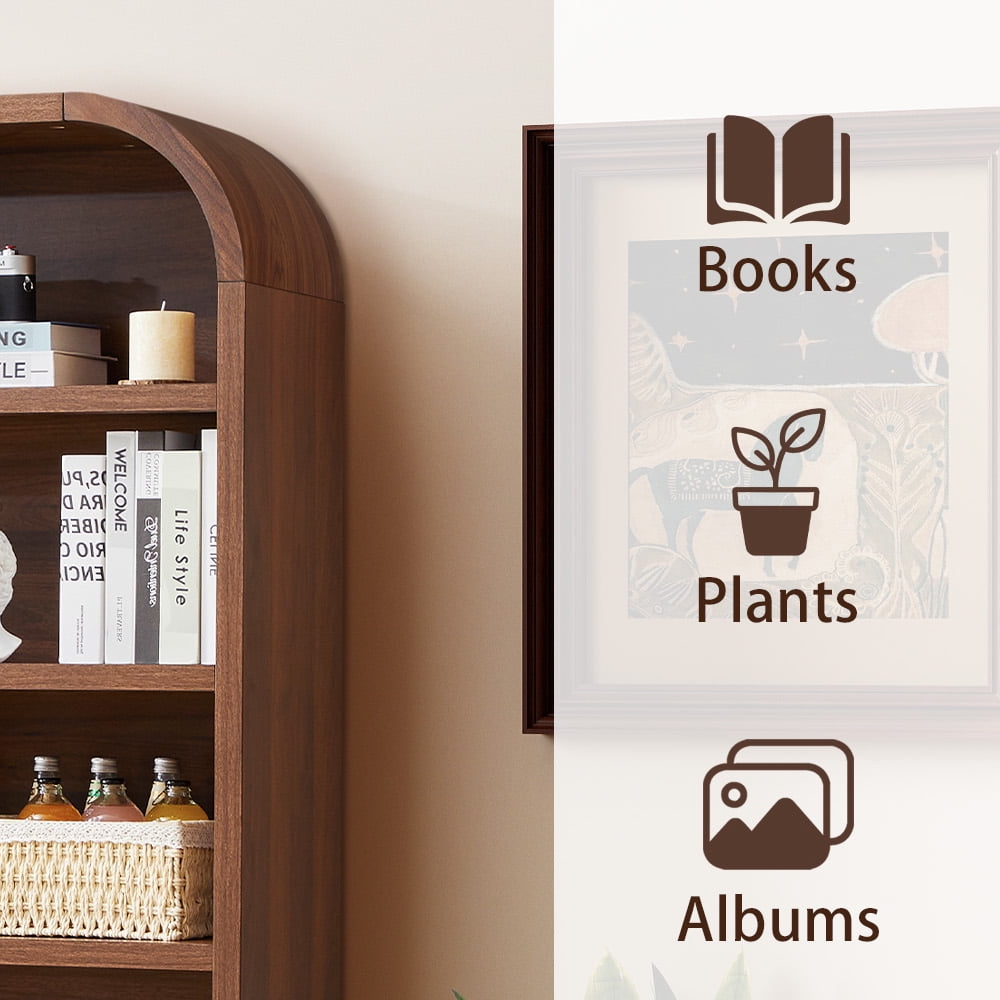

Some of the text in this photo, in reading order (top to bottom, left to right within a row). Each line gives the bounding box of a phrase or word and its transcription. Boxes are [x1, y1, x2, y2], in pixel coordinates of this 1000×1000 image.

[114, 448, 128, 533] WELCOME
[172, 510, 189, 606] Life Style
